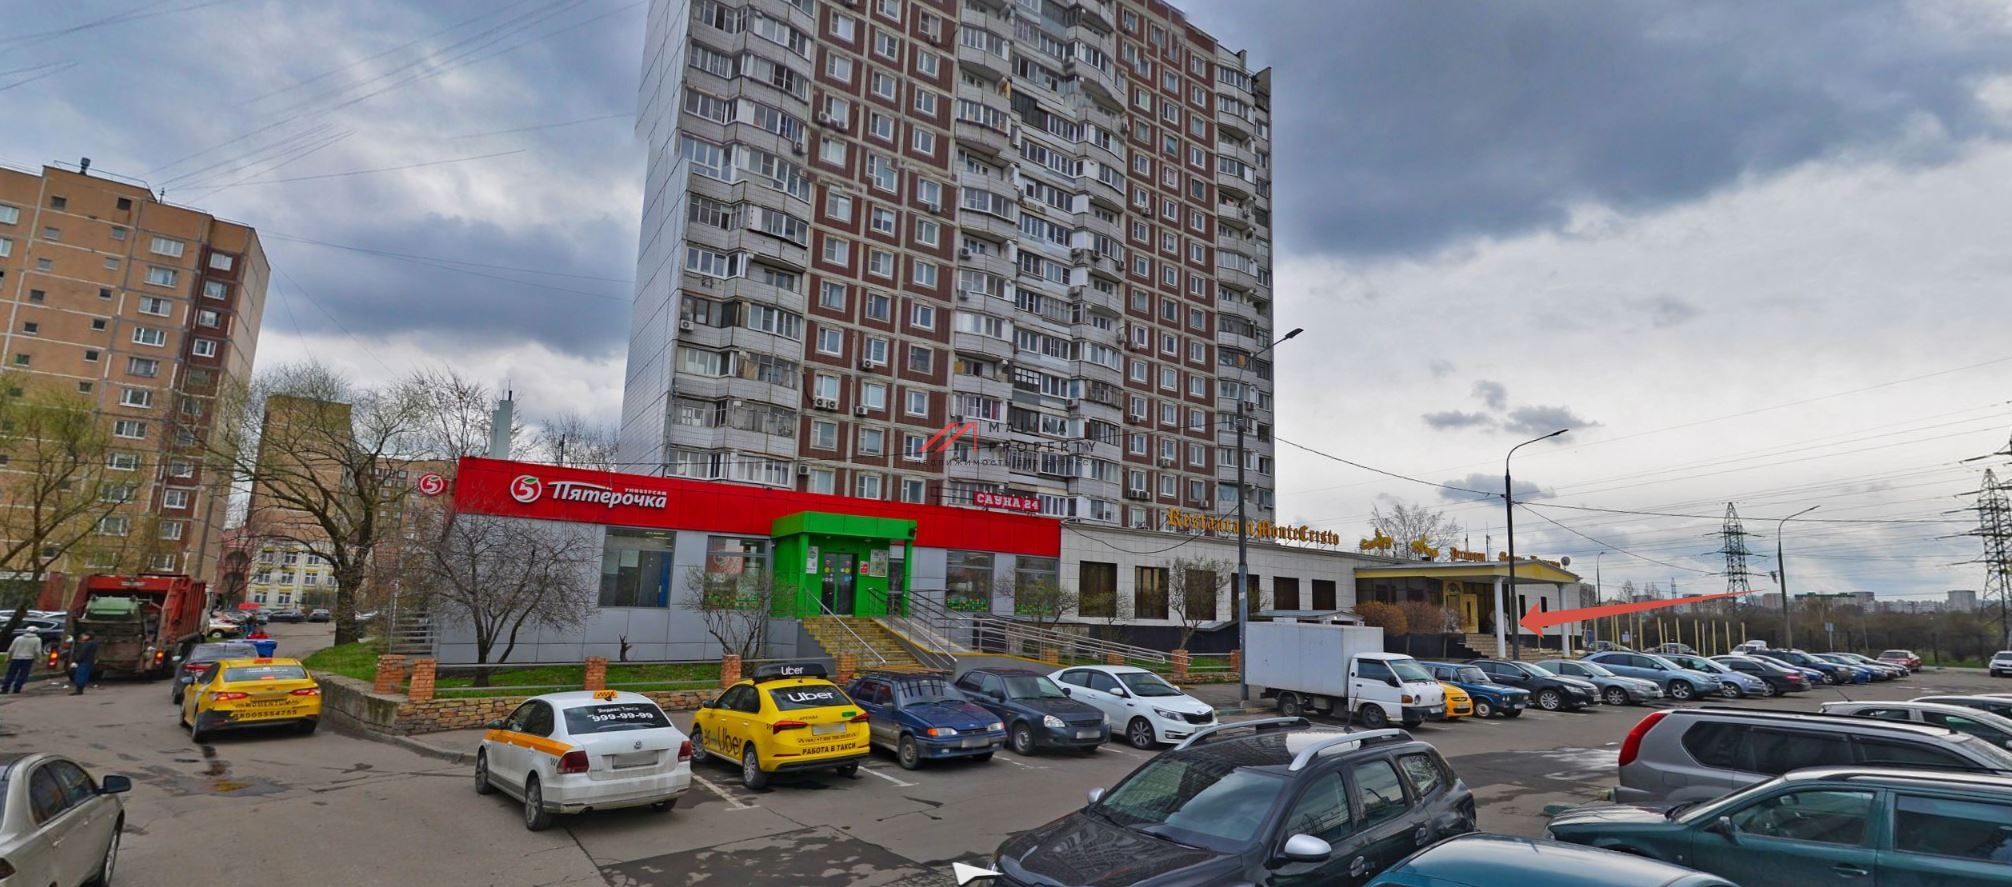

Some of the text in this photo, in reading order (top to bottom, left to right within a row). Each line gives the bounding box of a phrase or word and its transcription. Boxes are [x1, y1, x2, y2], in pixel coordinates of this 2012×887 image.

[548, 480, 668, 509] Пятерочка
[624, 487, 668, 497] УНИВЕРСАМ
[976, 493, 1039, 510] САУНА 24
[781, 665, 804, 676] Uber
[788, 691, 833, 703] Uber
[593, 712, 653, 722] 999-99-99
[717, 725, 742, 756] Uber
[802, 747, 829, 755] РАБОТА
[837, 742, 856, 751] ТАКСИ
